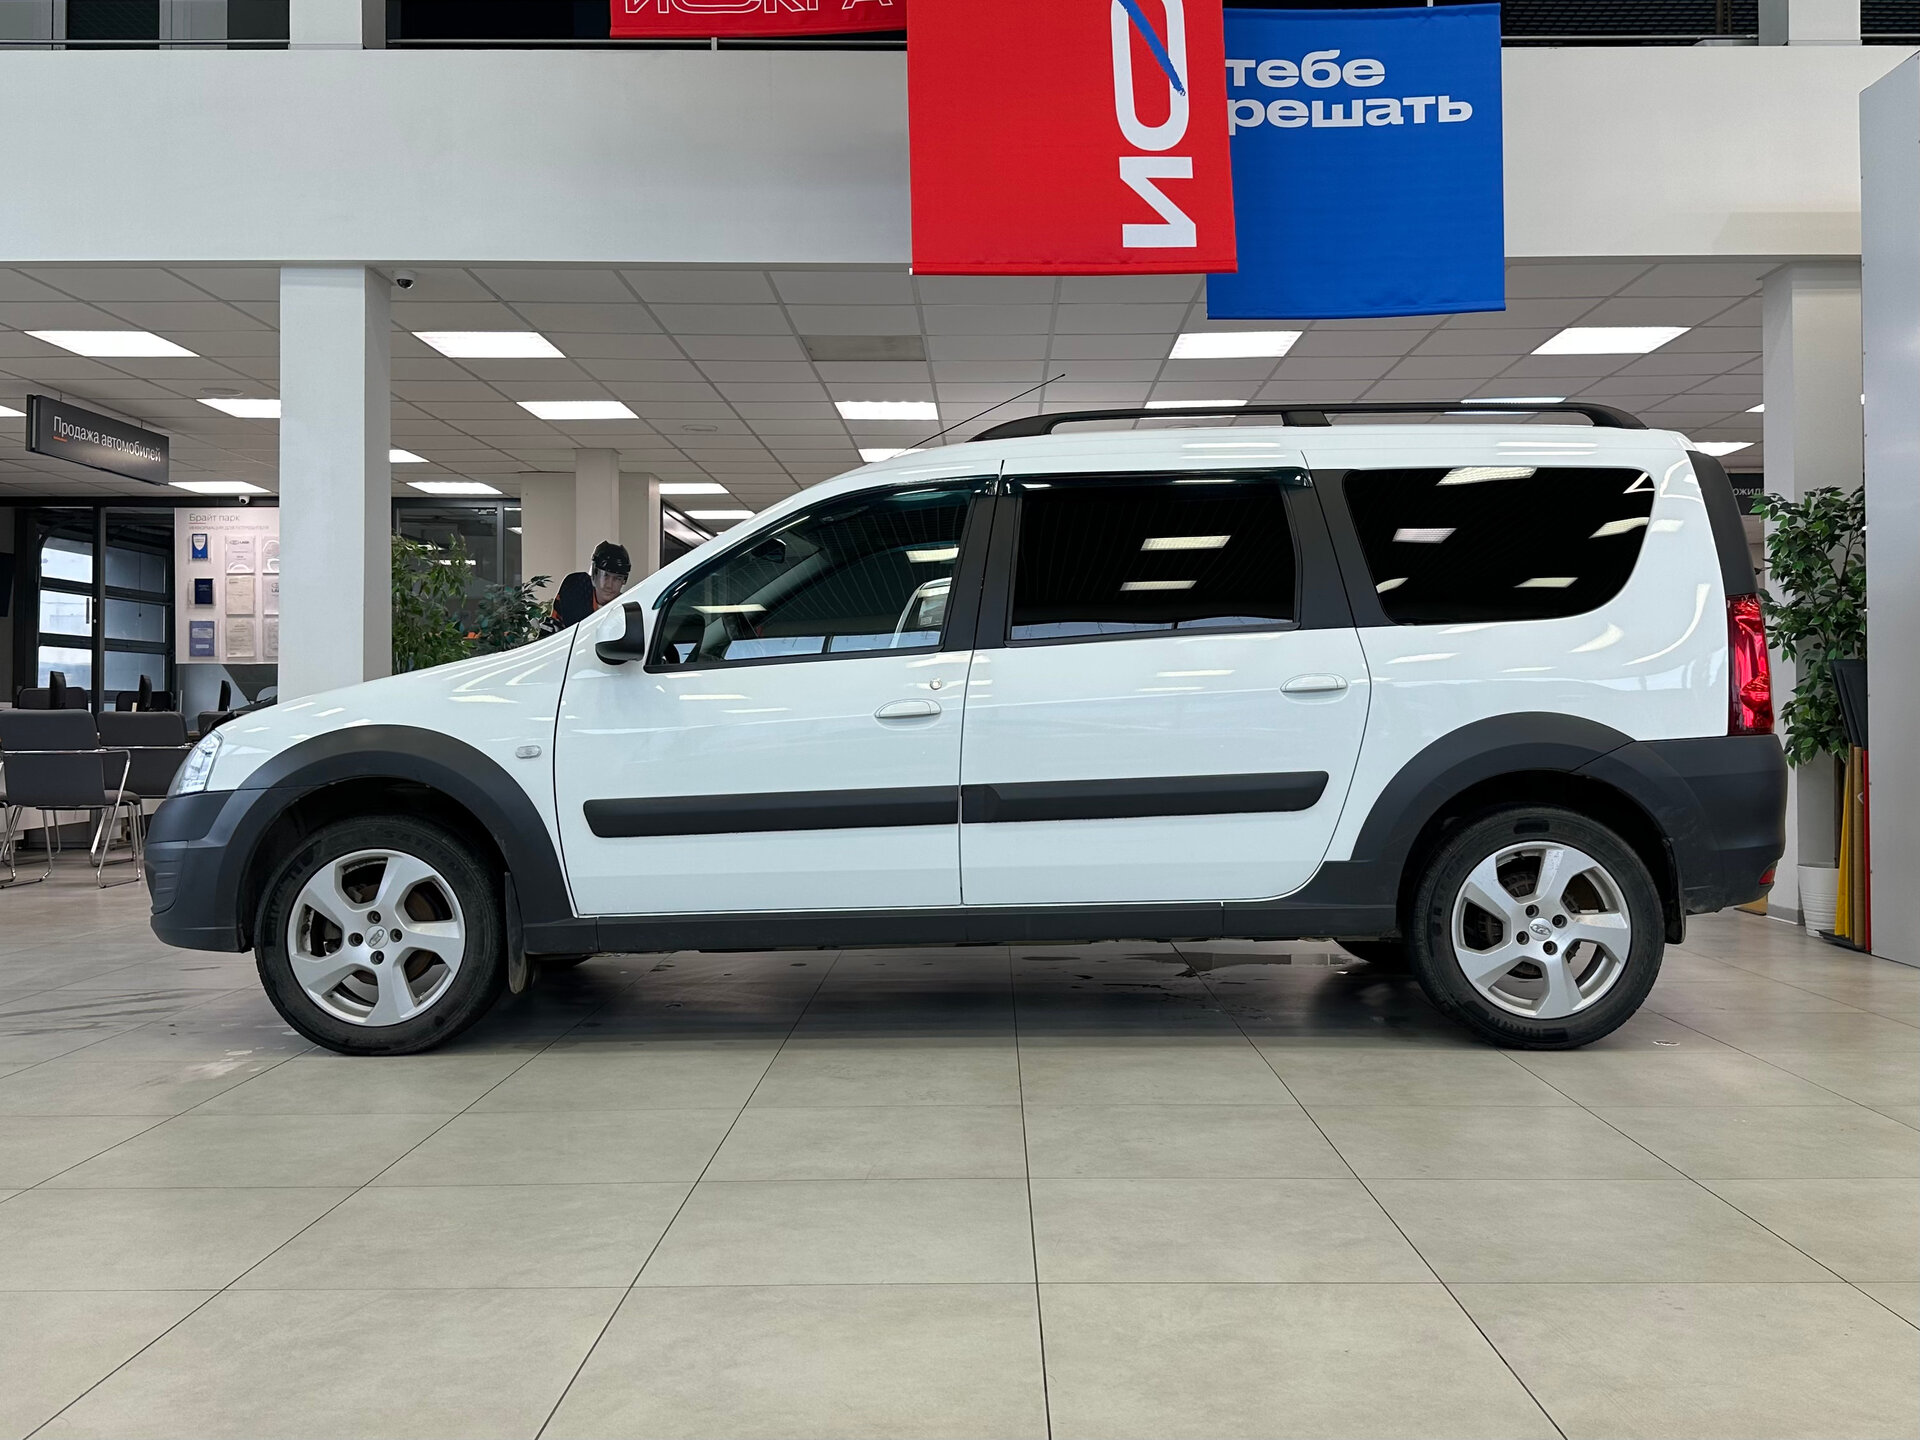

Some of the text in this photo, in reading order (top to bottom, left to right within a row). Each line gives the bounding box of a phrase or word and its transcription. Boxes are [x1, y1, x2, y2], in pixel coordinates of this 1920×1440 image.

[1225, 49, 1386, 88] тебе
[1227, 95, 1473, 136] решать
[53, 415, 161, 462] Продажа автомобилей
[189, 512, 240, 523] Брайт парк
